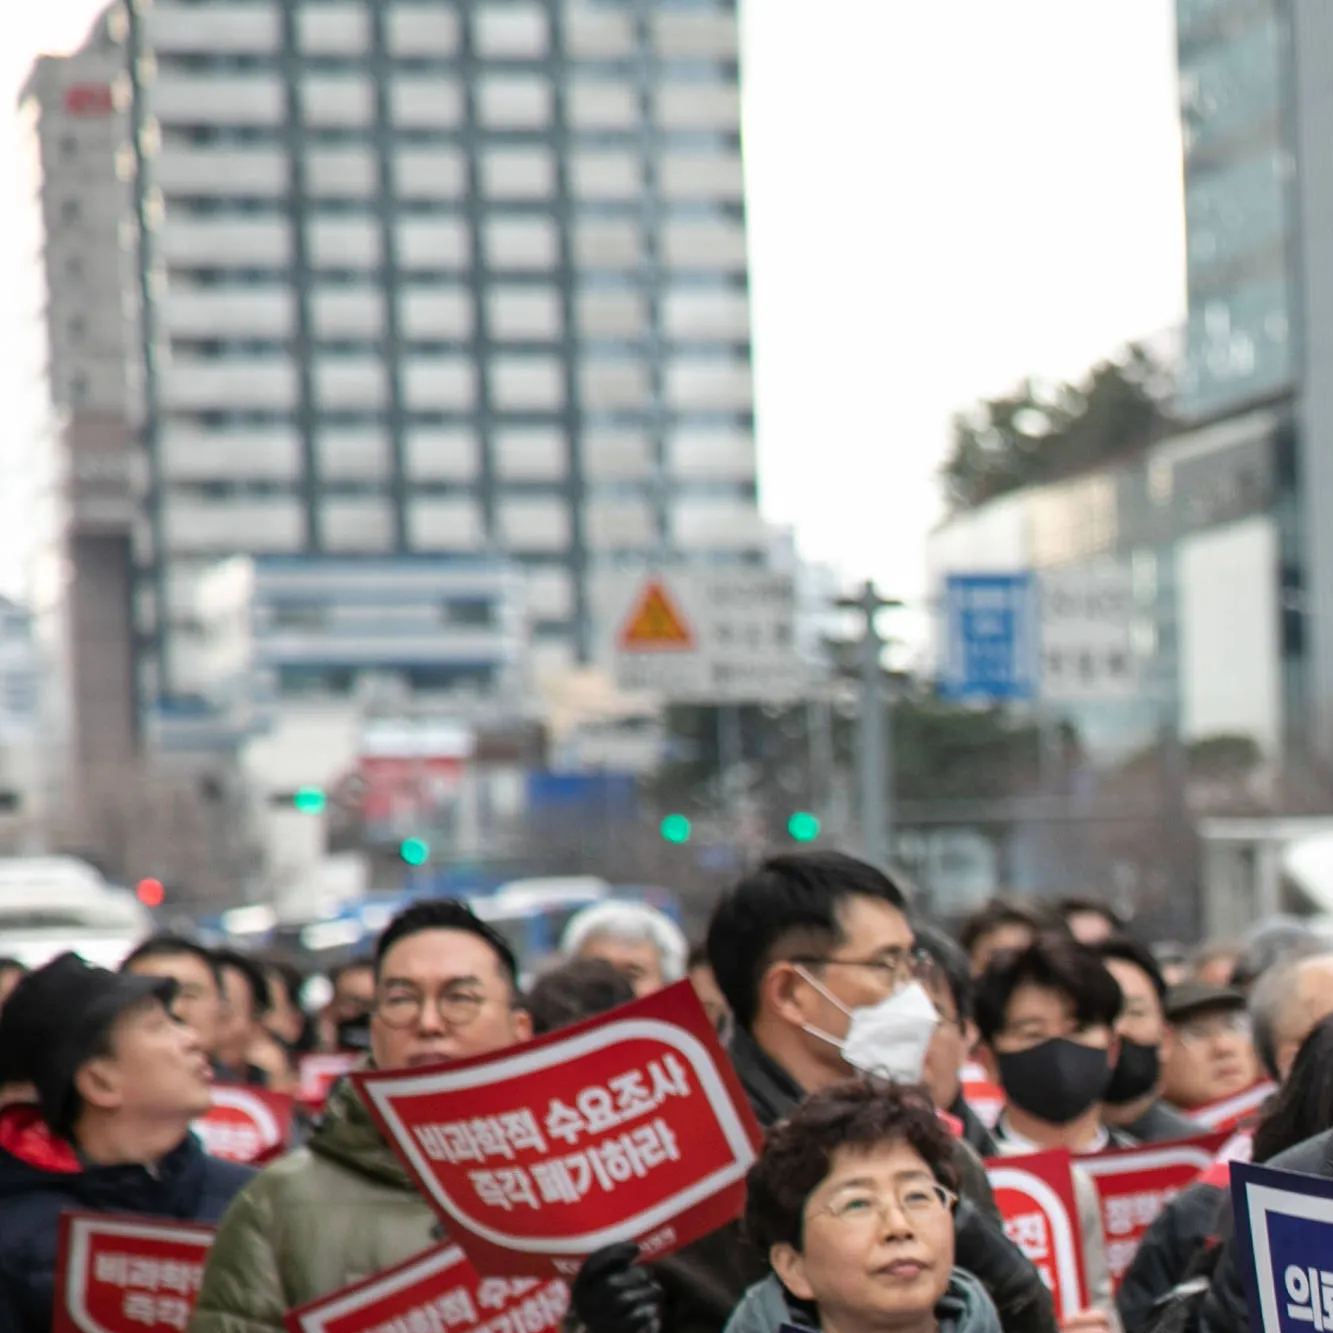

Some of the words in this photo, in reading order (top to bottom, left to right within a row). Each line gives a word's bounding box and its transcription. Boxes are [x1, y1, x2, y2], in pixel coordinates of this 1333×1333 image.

[413, 1107, 548, 1164] 비과학적
[544, 1052, 692, 1144] 수요조사
[467, 1167, 542, 1211] 즉각
[528, 1119, 682, 1206] 폐기하라
